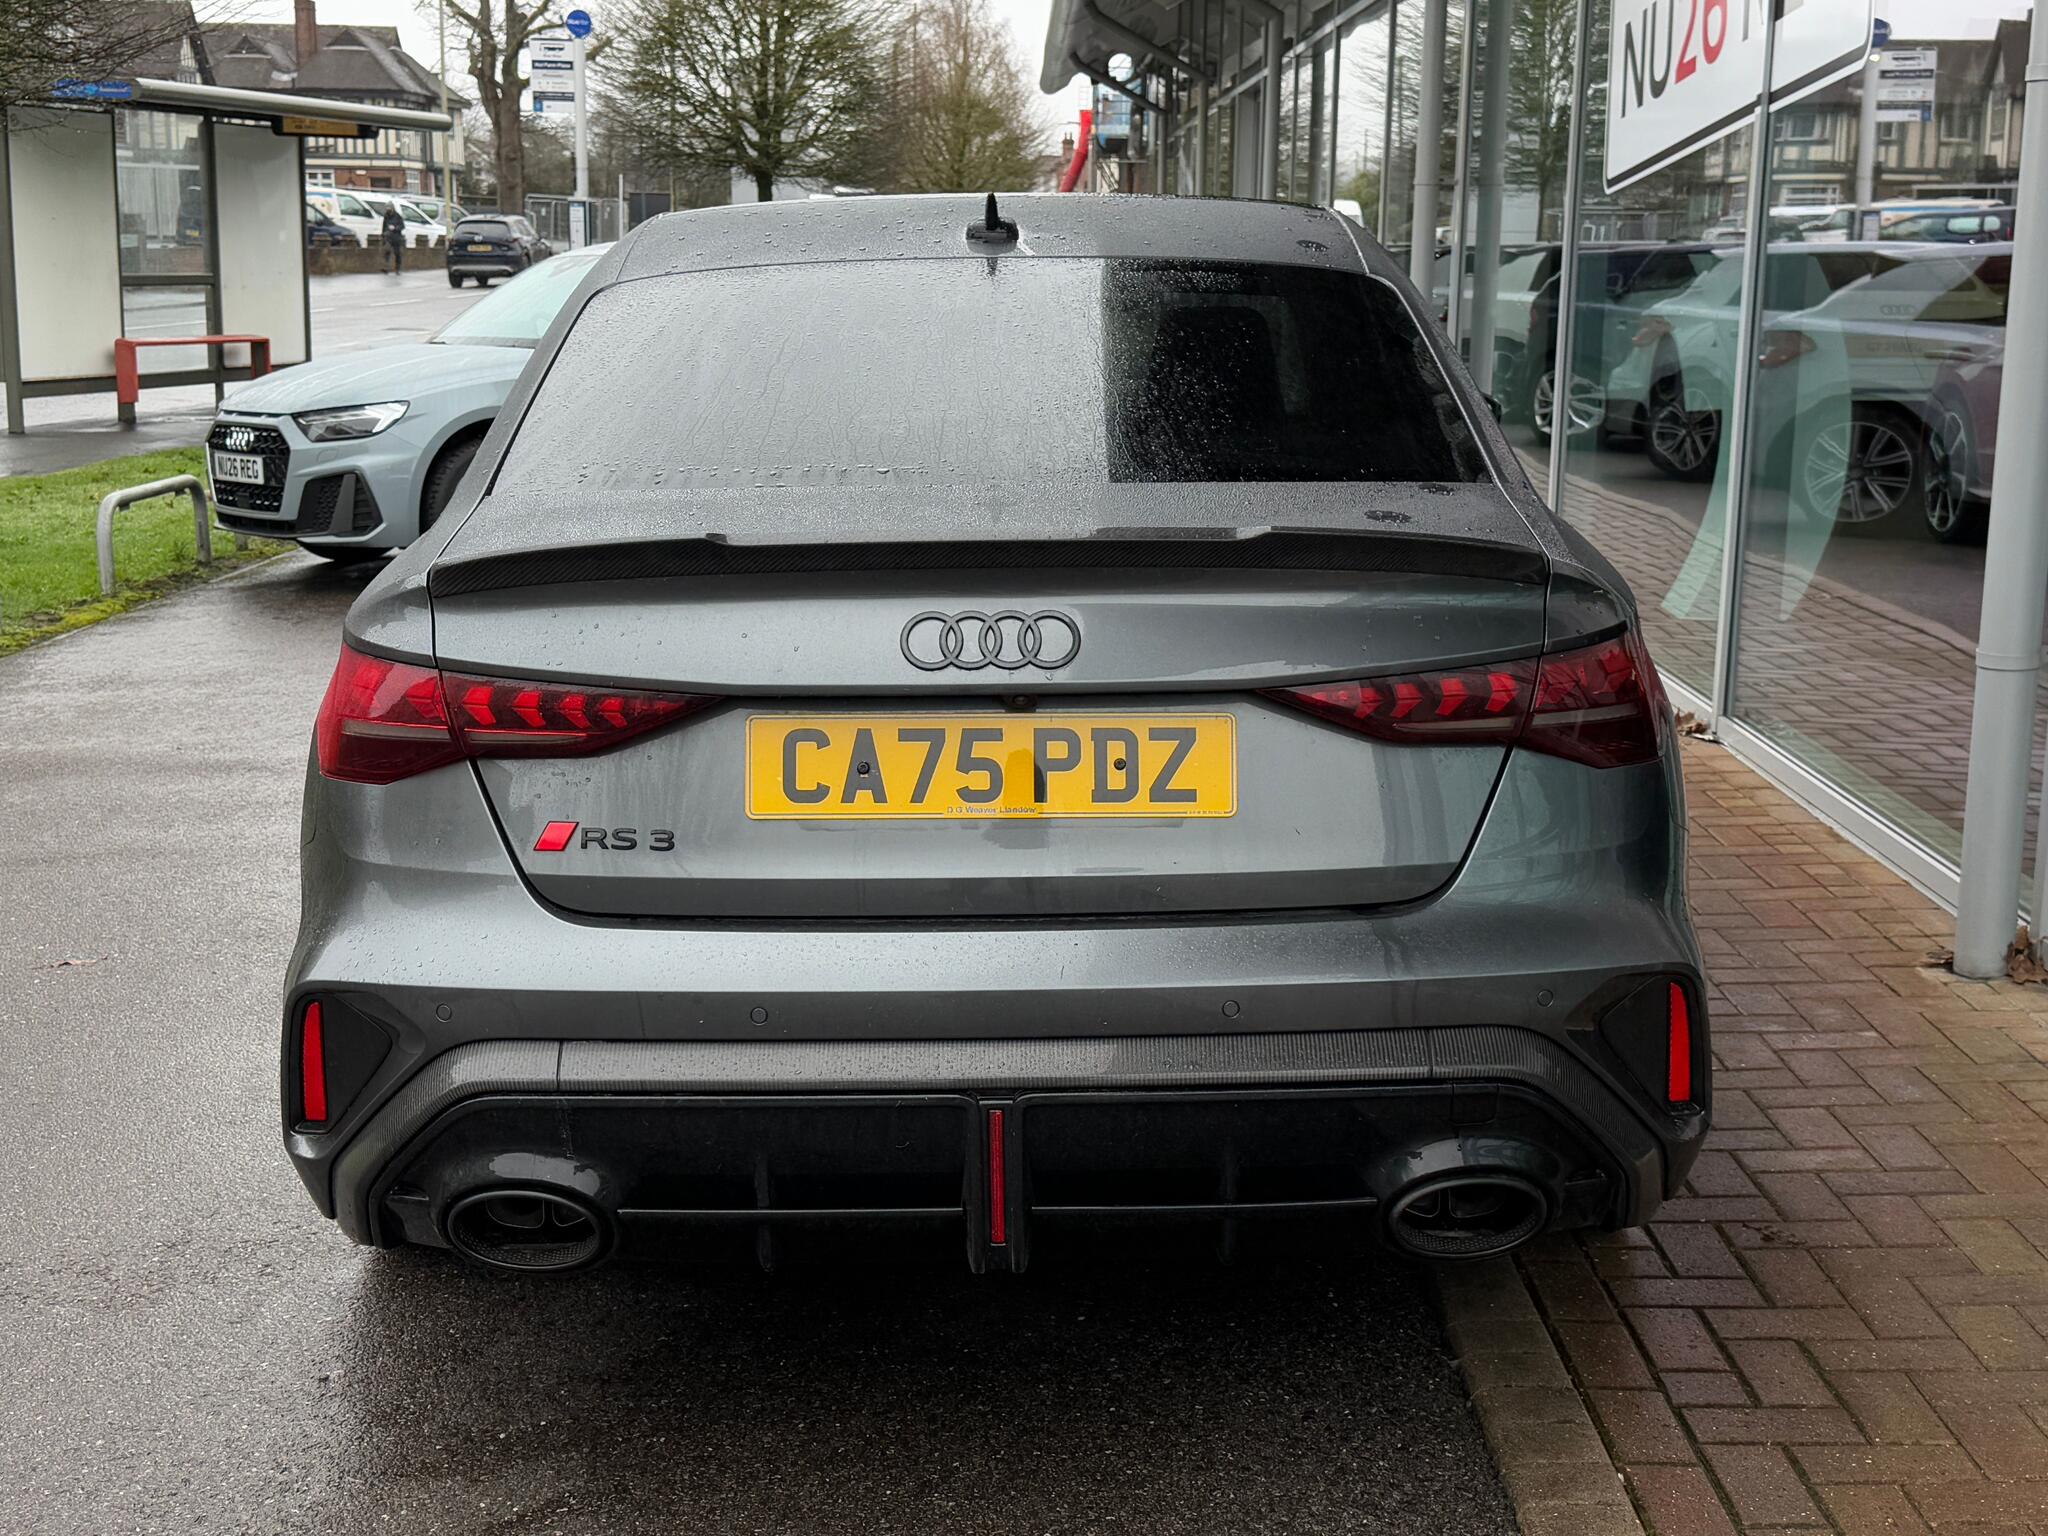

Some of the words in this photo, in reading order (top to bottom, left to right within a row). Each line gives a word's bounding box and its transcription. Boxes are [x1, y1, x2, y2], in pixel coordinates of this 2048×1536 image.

[1621, 0, 1727, 118] NU26
[218, 455, 239, 477] NU26
[240, 459, 259, 479] REG
[781, 727, 1003, 804] CA75
[1033, 727, 1197, 803] PDZ
[580, 827, 637, 850] RS
[649, 829, 675, 851] 3
